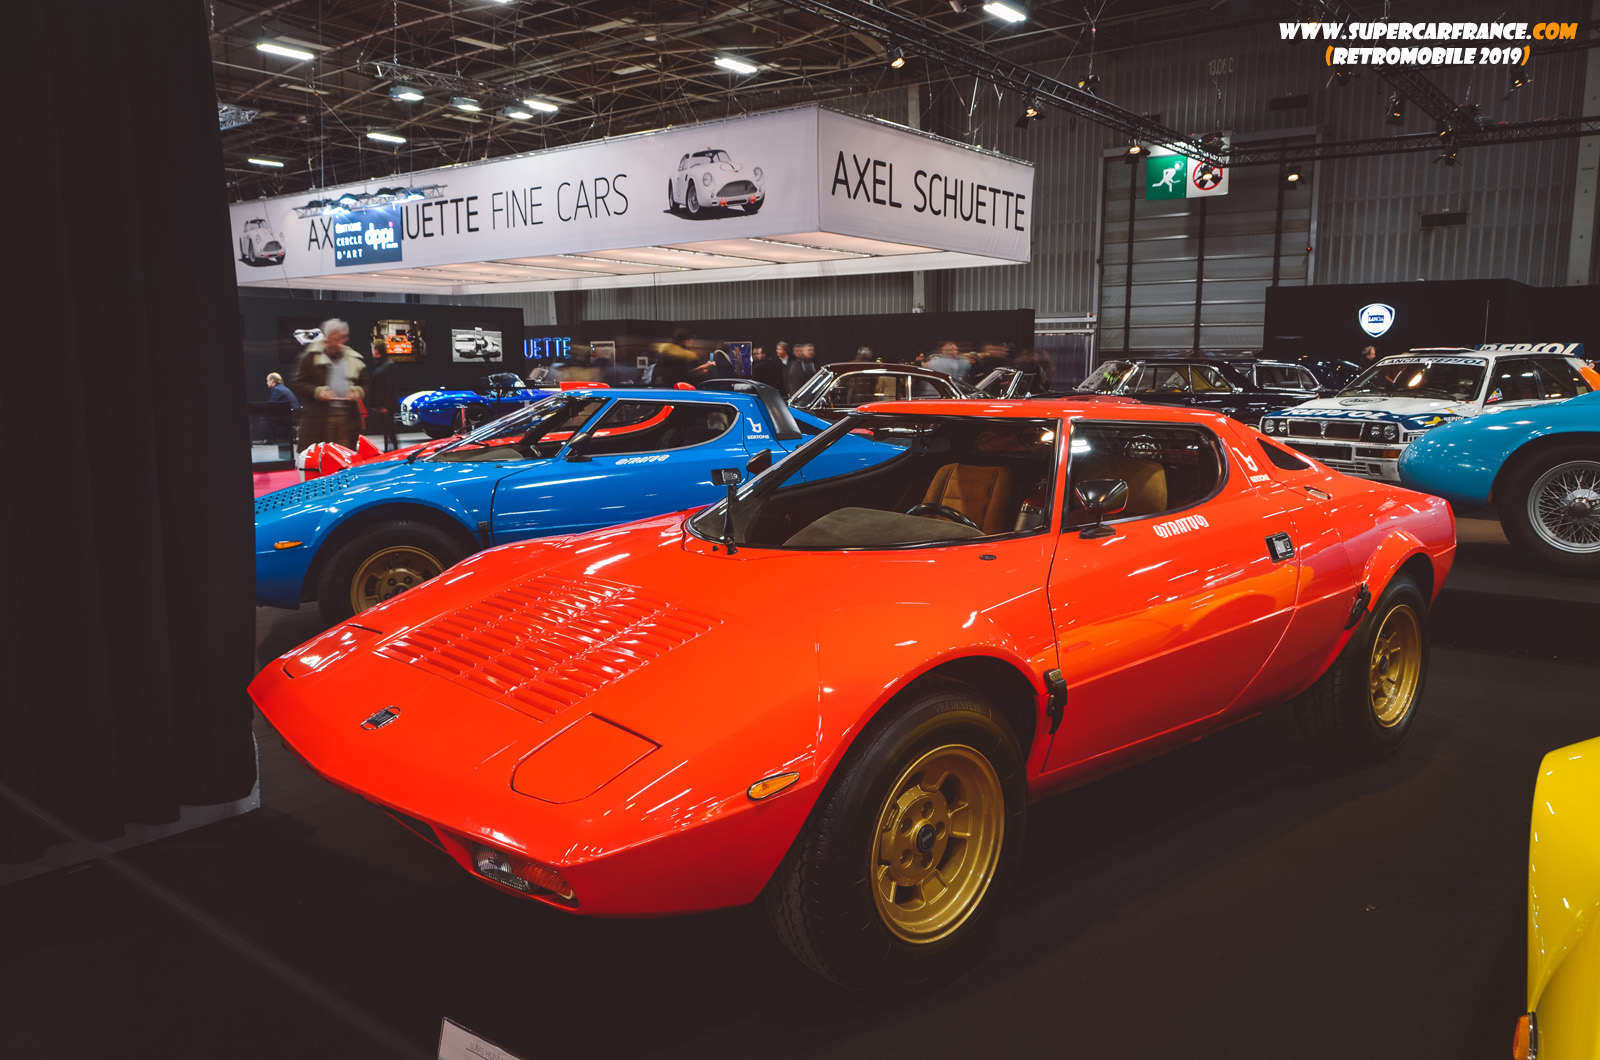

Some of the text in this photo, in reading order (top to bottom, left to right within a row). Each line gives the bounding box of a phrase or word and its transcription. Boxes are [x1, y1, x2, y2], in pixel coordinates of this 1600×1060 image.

[831, 150, 1026, 232] AXEL SCHUETTE
[308, 173, 629, 251] AX UETTE FINE CARS
[336, 235, 363, 247] CERCLE
[336, 248, 363, 260] D'ART
[524, 337, 571, 359] UETTE
[1152, 514, 1210, 539] STRATOS
